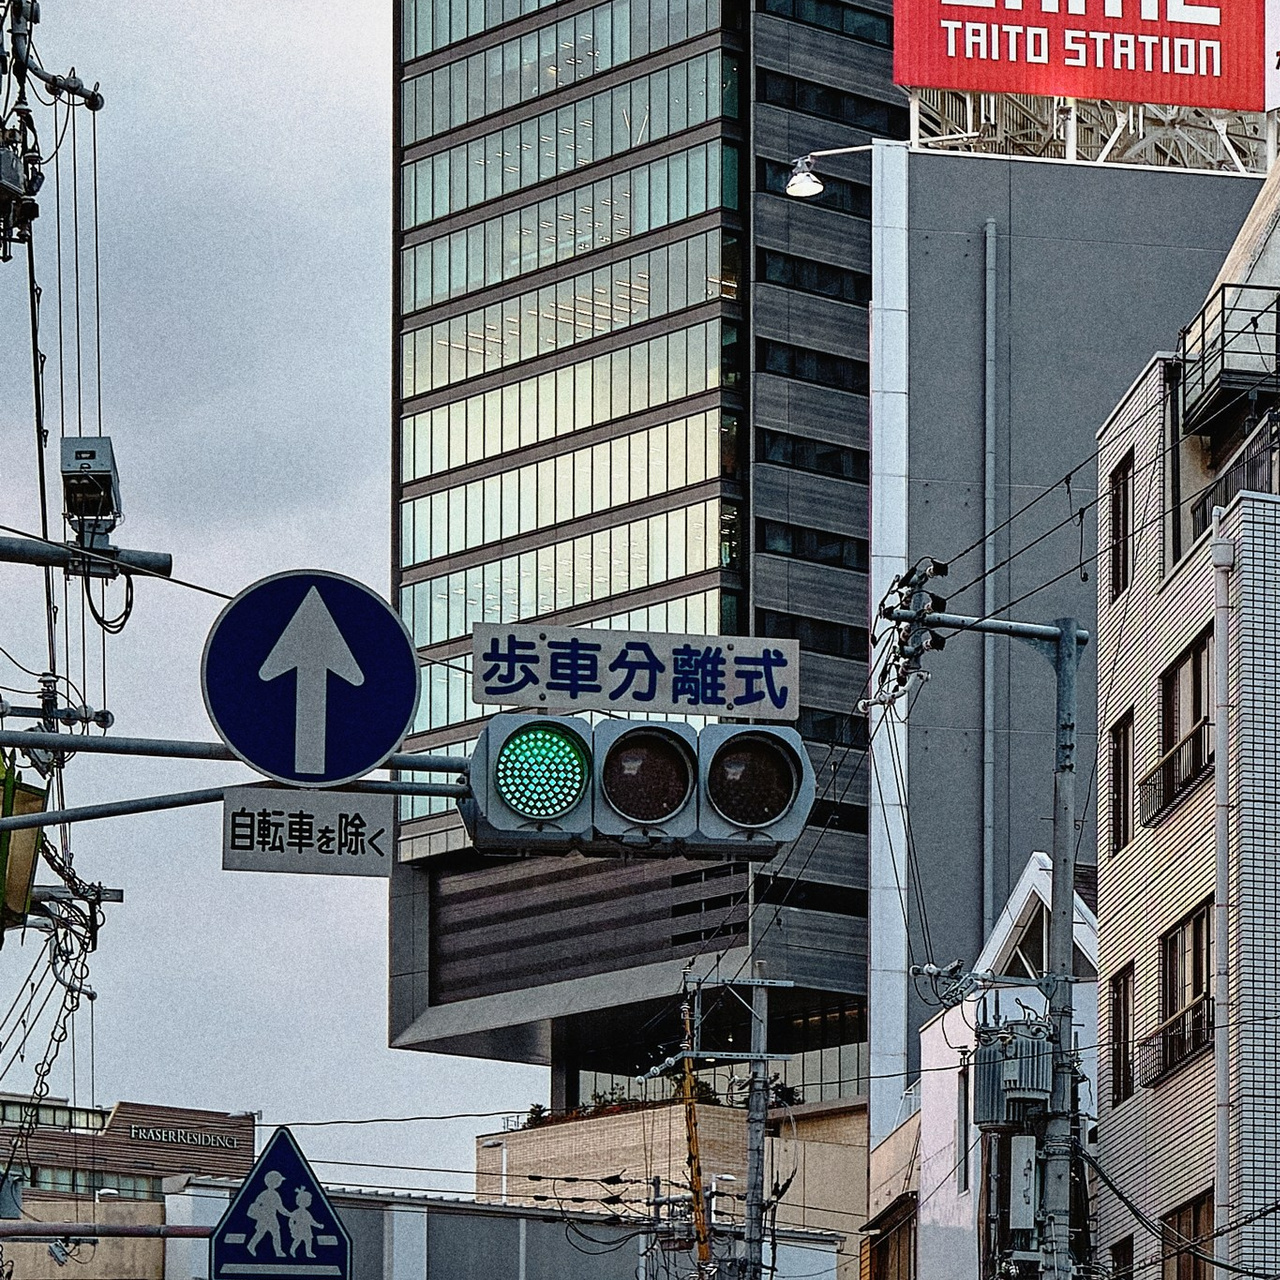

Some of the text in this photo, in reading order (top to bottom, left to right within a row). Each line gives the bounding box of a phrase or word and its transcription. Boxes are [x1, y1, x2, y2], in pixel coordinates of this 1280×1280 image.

[941, 19, 1221, 77] TAITO STATION
[482, 635, 789, 710] 歩車分離式
[230, 807, 387, 858] 自転車を除く
